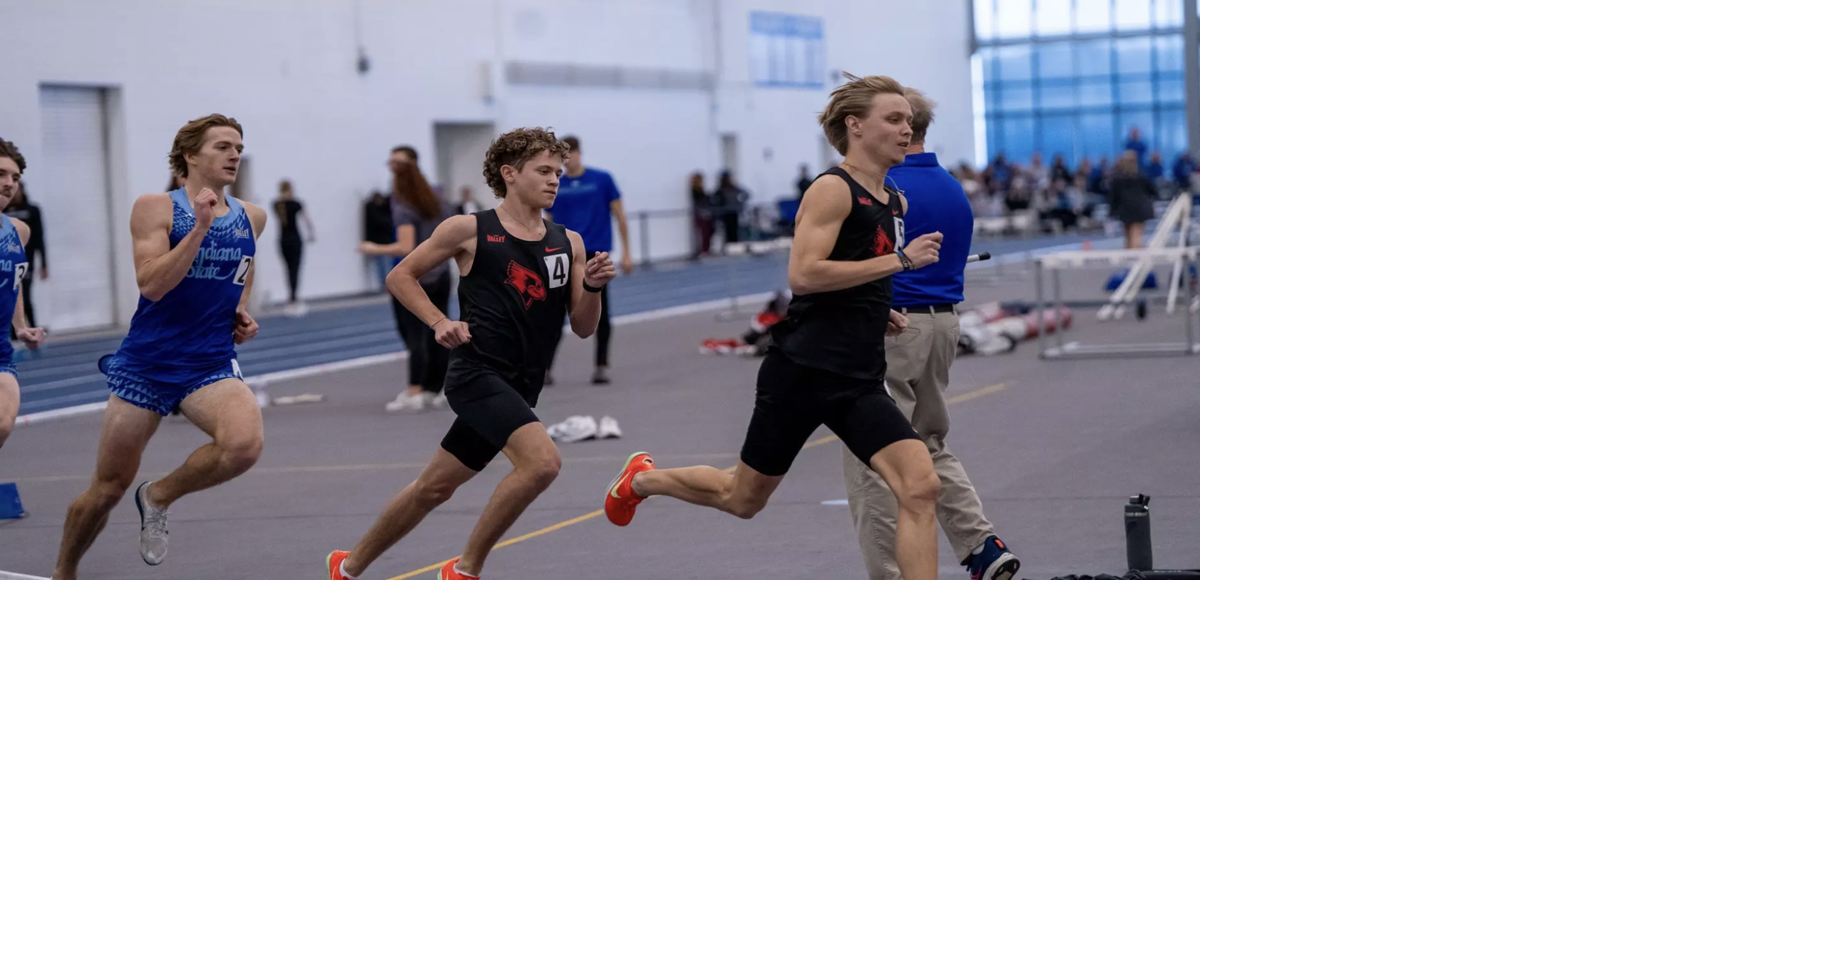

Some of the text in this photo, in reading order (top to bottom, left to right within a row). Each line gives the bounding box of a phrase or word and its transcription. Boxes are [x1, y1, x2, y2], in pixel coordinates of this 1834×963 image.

[486, 234, 506, 243] VALLEY
[236, 257, 251, 284] 2
[552, 256, 566, 285] 4
